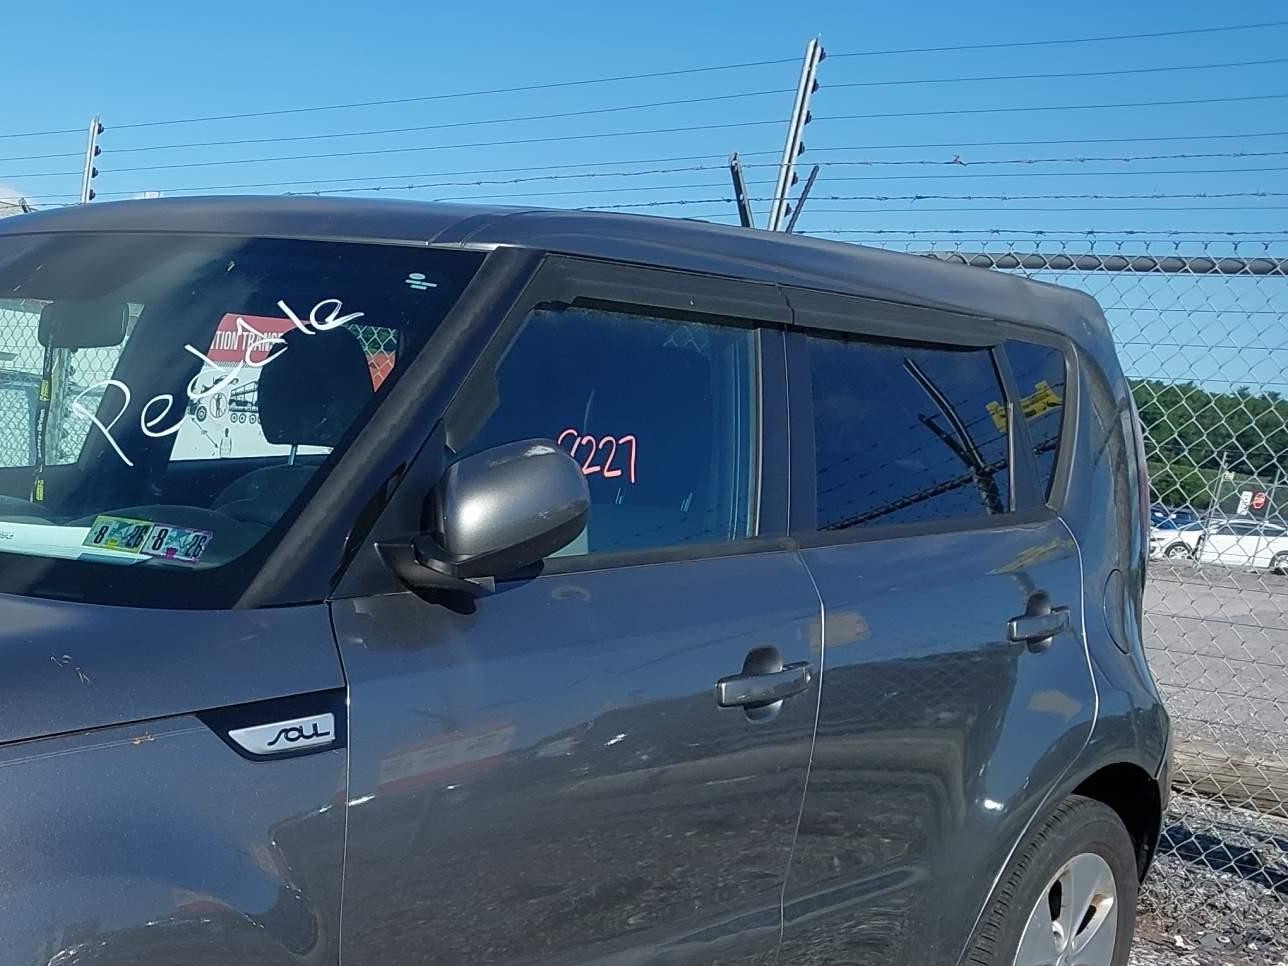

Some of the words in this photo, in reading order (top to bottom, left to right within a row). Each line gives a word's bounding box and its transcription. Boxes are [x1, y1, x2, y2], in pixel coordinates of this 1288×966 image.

[210, 330, 239, 351] TION
[240, 330, 284, 351] TRANS
[125, 525, 148, 549] 26
[184, 534, 208, 558] 26
[267, 722, 331, 746] SOUL
